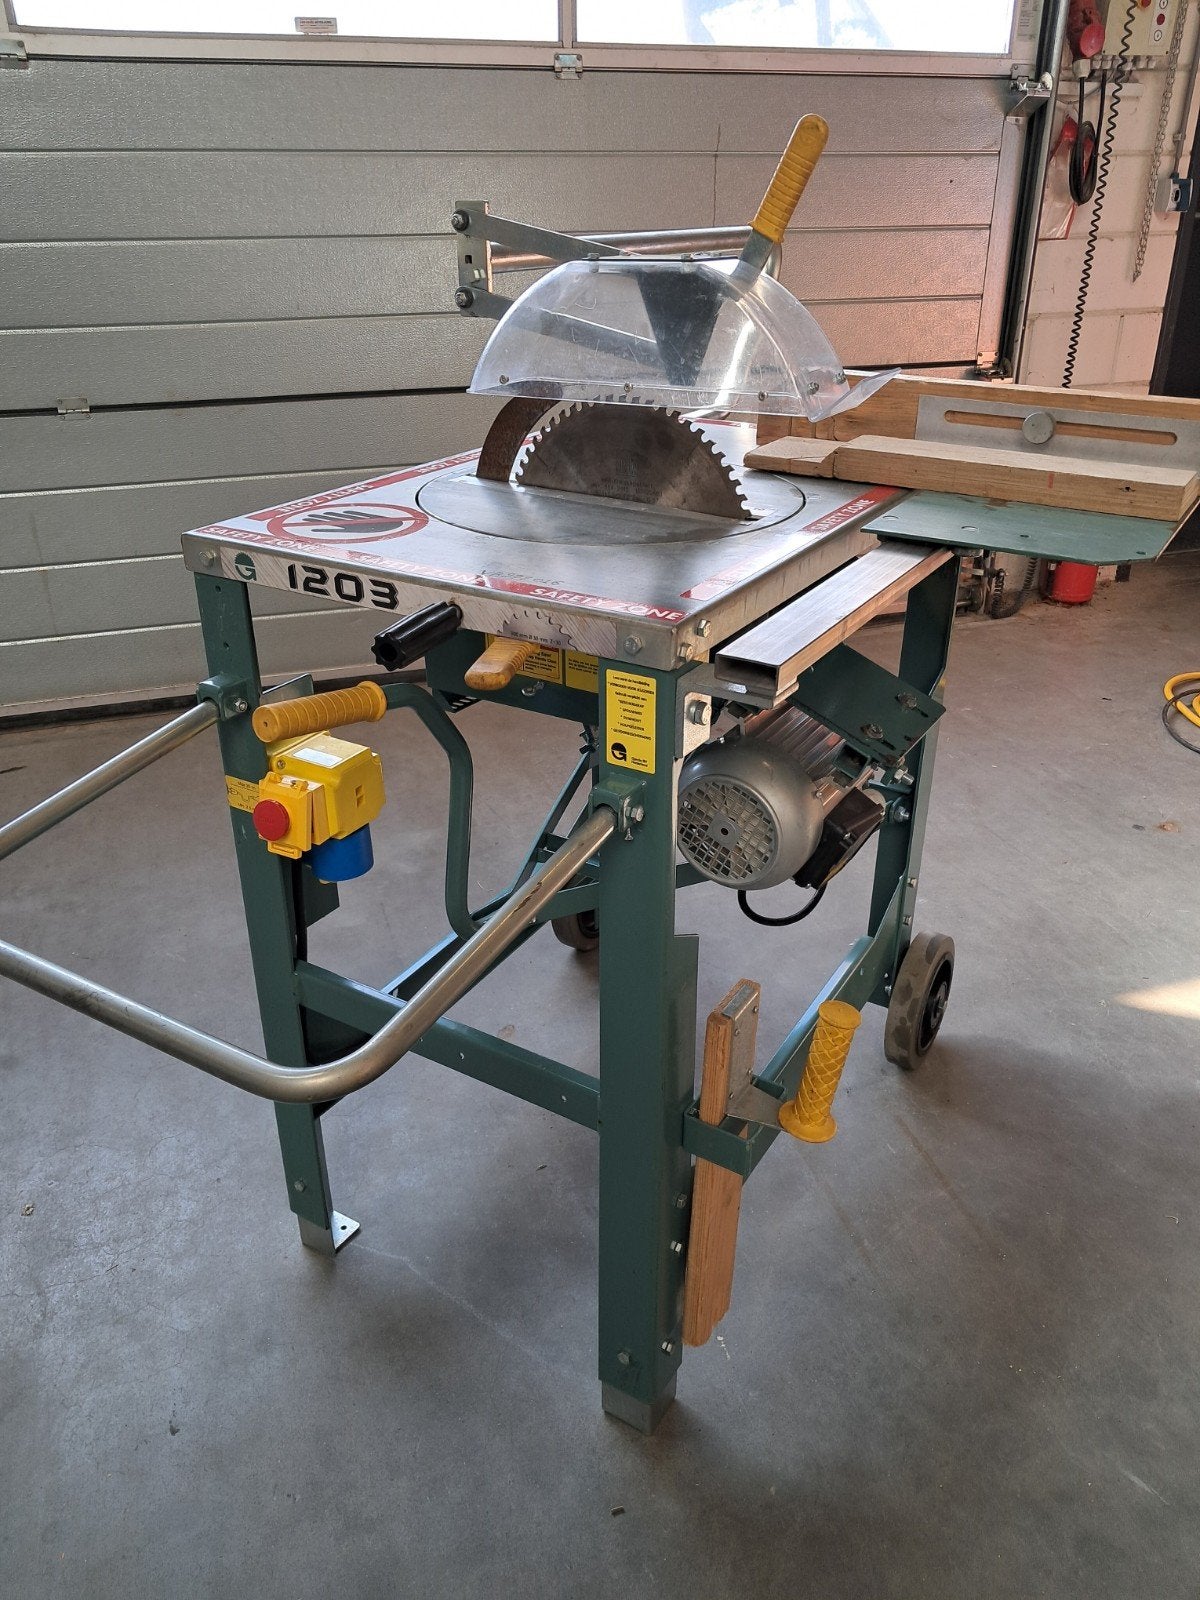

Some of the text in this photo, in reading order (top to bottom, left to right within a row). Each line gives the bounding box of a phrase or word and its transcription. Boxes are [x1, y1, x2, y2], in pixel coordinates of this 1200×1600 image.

[203, 526, 268, 541] SAFETY
[811, 512, 850, 532] SAFETY
[287, 563, 399, 610] 1203
[529, 588, 683, 620] SAFETY ZONE
